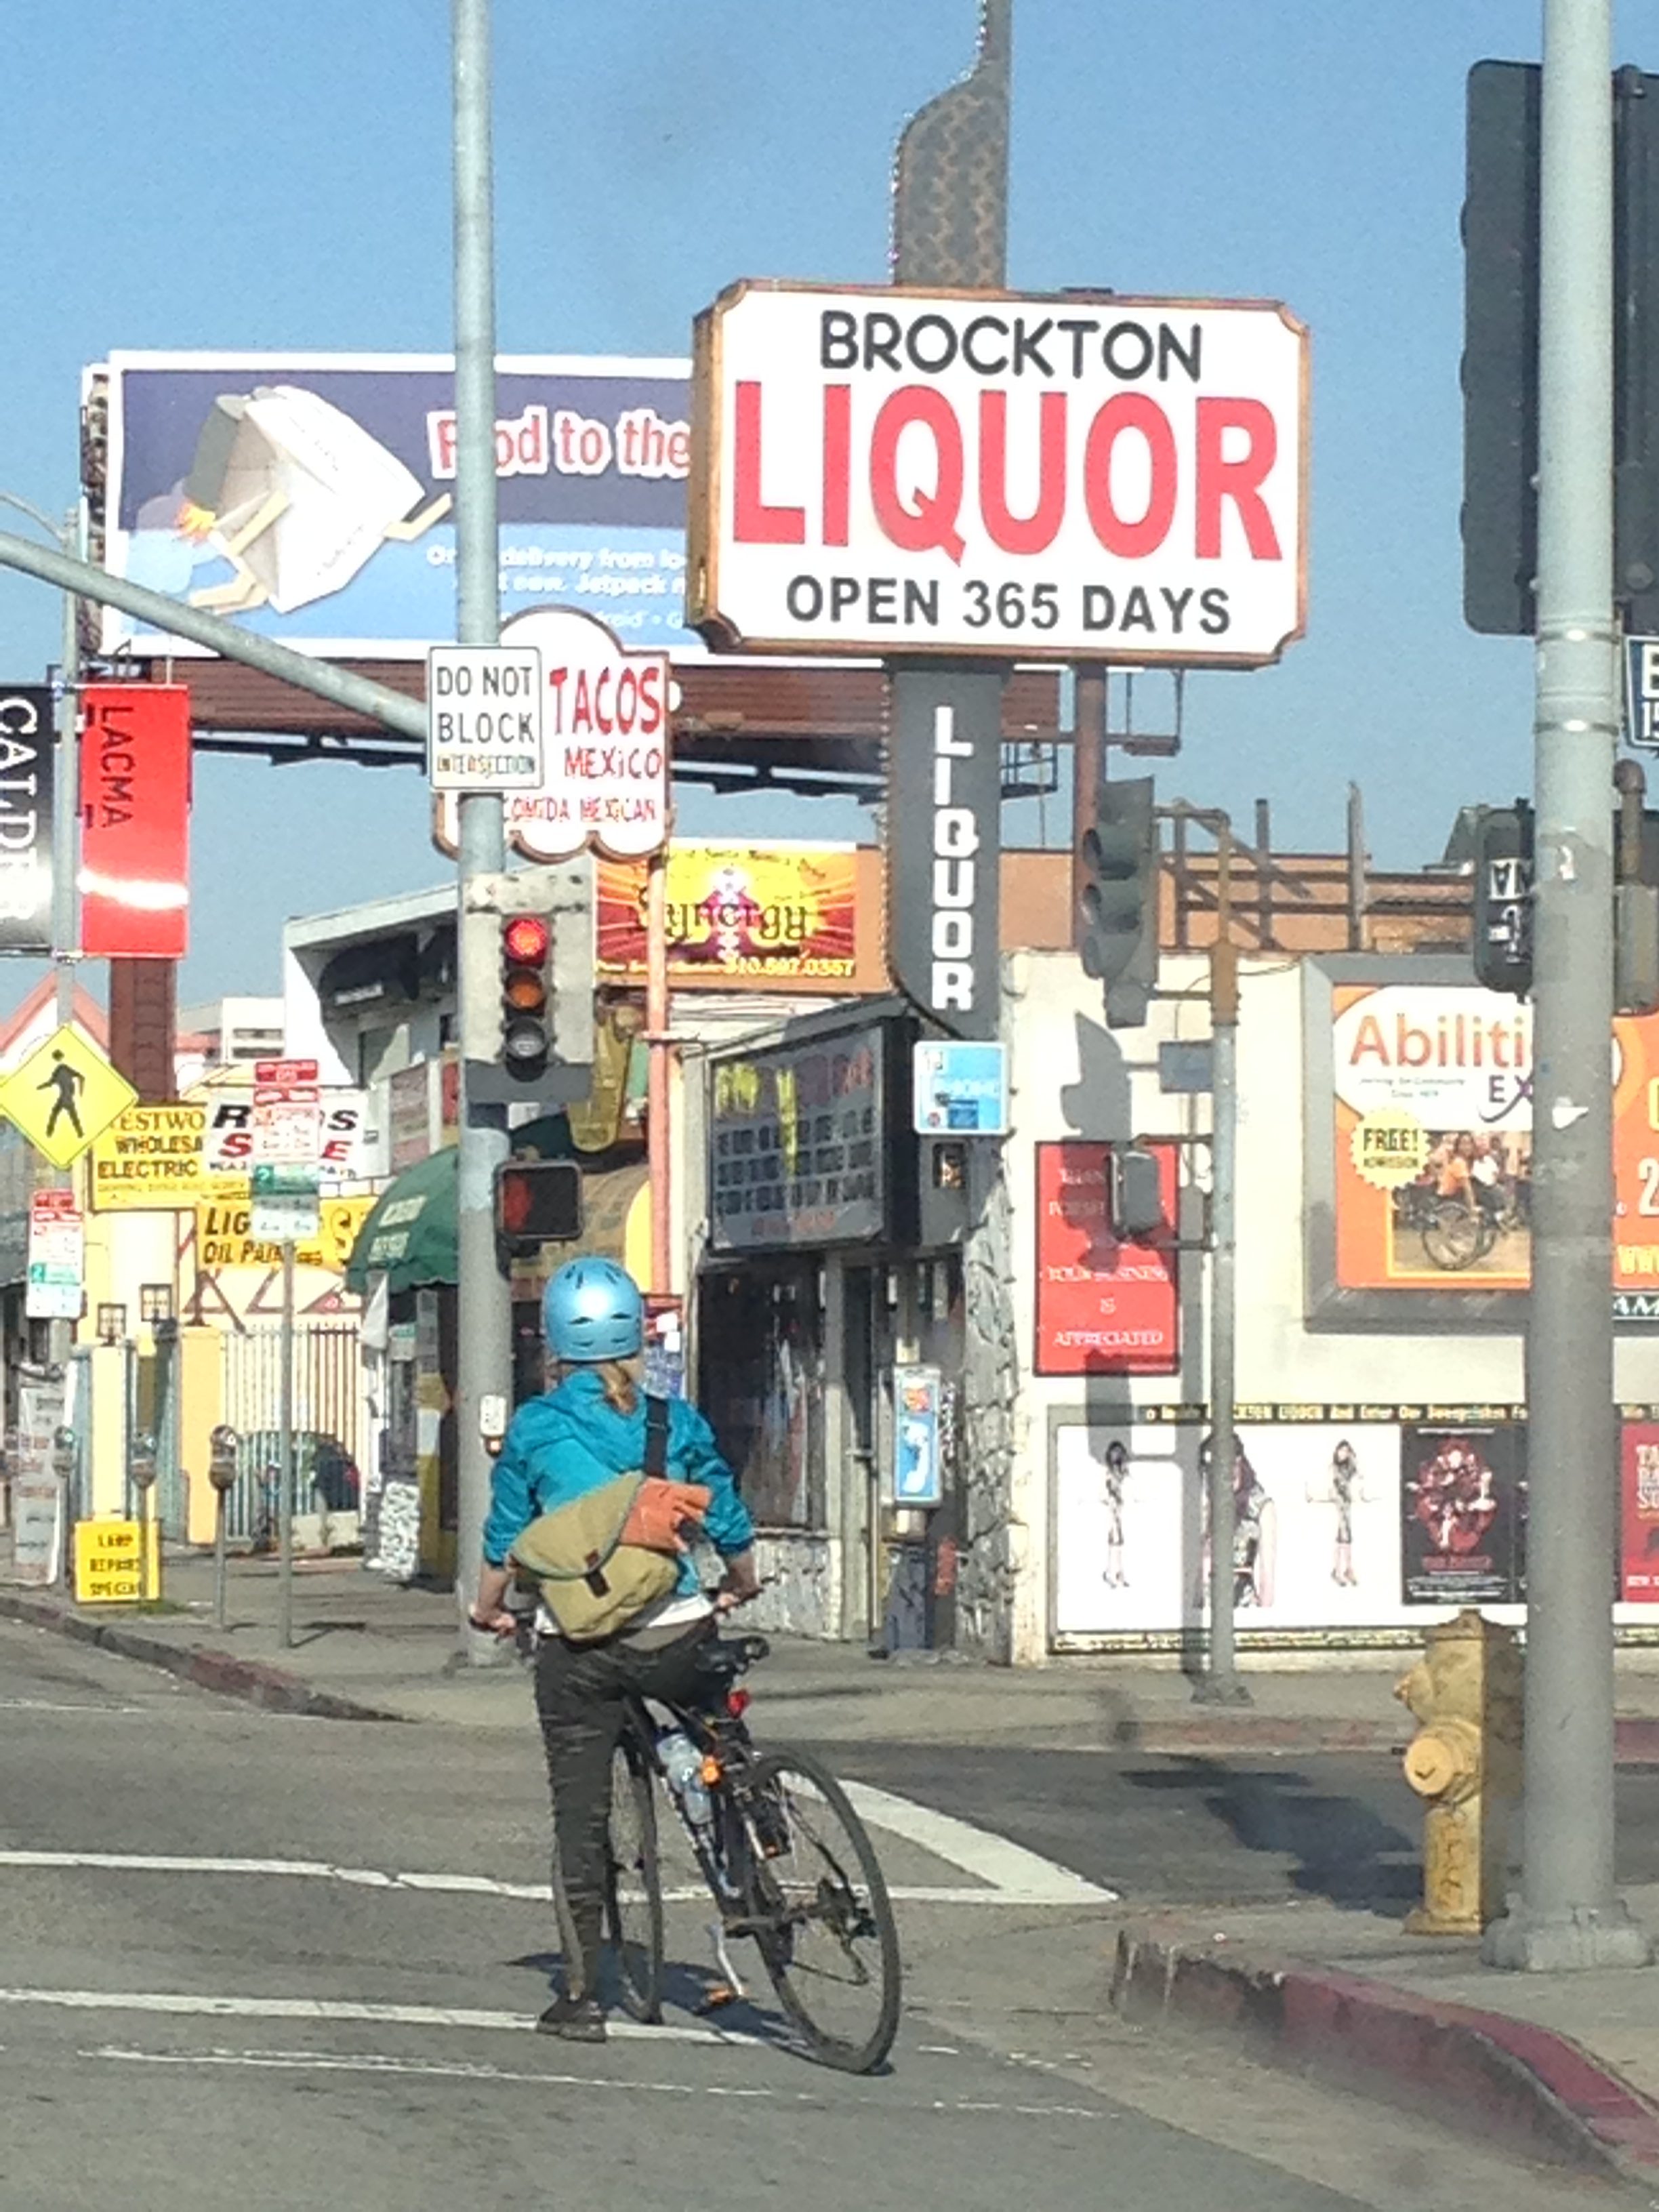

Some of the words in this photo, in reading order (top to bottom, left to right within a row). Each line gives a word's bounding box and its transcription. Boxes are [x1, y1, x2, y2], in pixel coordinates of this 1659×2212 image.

[820, 310, 1202, 382] BROCKTON
[437, 415, 540, 470] Fod
[560, 417, 604, 466] to
[624, 416, 690, 468] the
[733, 380, 1283, 567] LIQUOR
[786, 575, 939, 627] OPEN
[962, 579, 1060, 630] 365
[1082, 584, 1231, 635] DAYS
[437, 666, 472, 697] DO
[483, 666, 533, 697] NOT
[549, 666, 661, 736] TACOS
[437, 712, 535, 743] BLOCK
[100, 705, 134, 829] LACMA
[931, 705, 979, 1010] LIQUOR
[1349, 1014, 1524, 1067] Abiliti
[1488, 1074, 1533, 1104] EX
[97, 1158, 199, 1180] ELECTRIC
[115, 1134, 203, 1154] WHOLESA
[1638, 1157, 1659, 1215] 2
[205, 1207, 251, 1236] LIG
[1053, 1330, 1164, 1347] APPRECIATED
